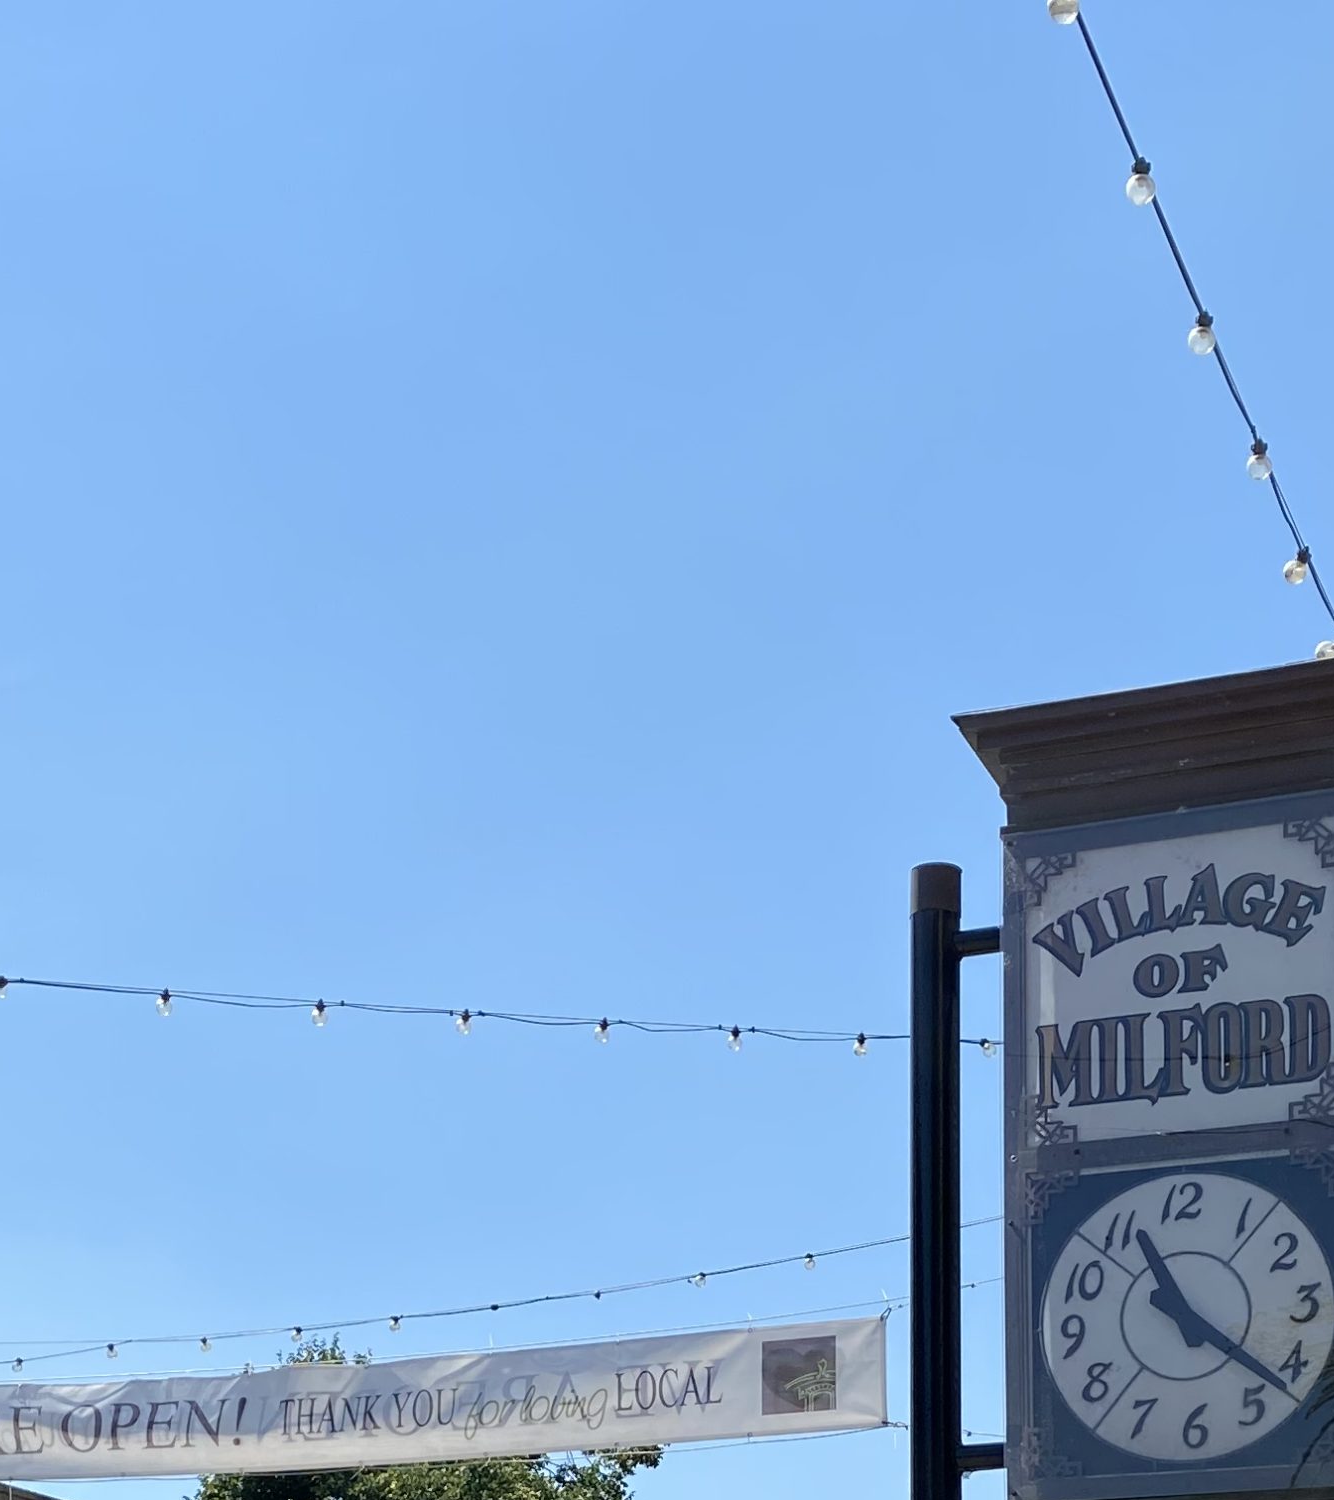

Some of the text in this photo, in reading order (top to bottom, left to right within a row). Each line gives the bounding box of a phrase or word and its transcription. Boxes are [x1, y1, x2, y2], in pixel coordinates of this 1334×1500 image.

[1033, 863, 1326, 977] VILLAGE
[1133, 944, 1228, 997] OF
[1036, 994, 1331, 1107] MILFORD
[1161, 1182, 1203, 1224] 12
[1235, 1198, 1252, 1239] 1
[1104, 1210, 1136, 1252] 11
[1270, 1232, 1299, 1272] 2
[1064, 1260, 1104, 1304] 10
[1289, 1282, 1321, 1323] 3
[1061, 1314, 1086, 1360] 9
[1081, 1361, 1113, 1403] 8
[1278, 1340, 1309, 1383] 4
[61, 1397, 247, 1453] OPEN!
[280, 1394, 382, 1436] THANK
[392, 1388, 458, 1428] YOU
[464, 1392, 517, 1440] for
[519, 1384, 608, 1430] loving
[614, 1365, 723, 1412] LOCAL
[1130, 1398, 1159, 1440] 7
[1182, 1403, 1208, 1449] 6
[1238, 1383, 1266, 1426] 5
